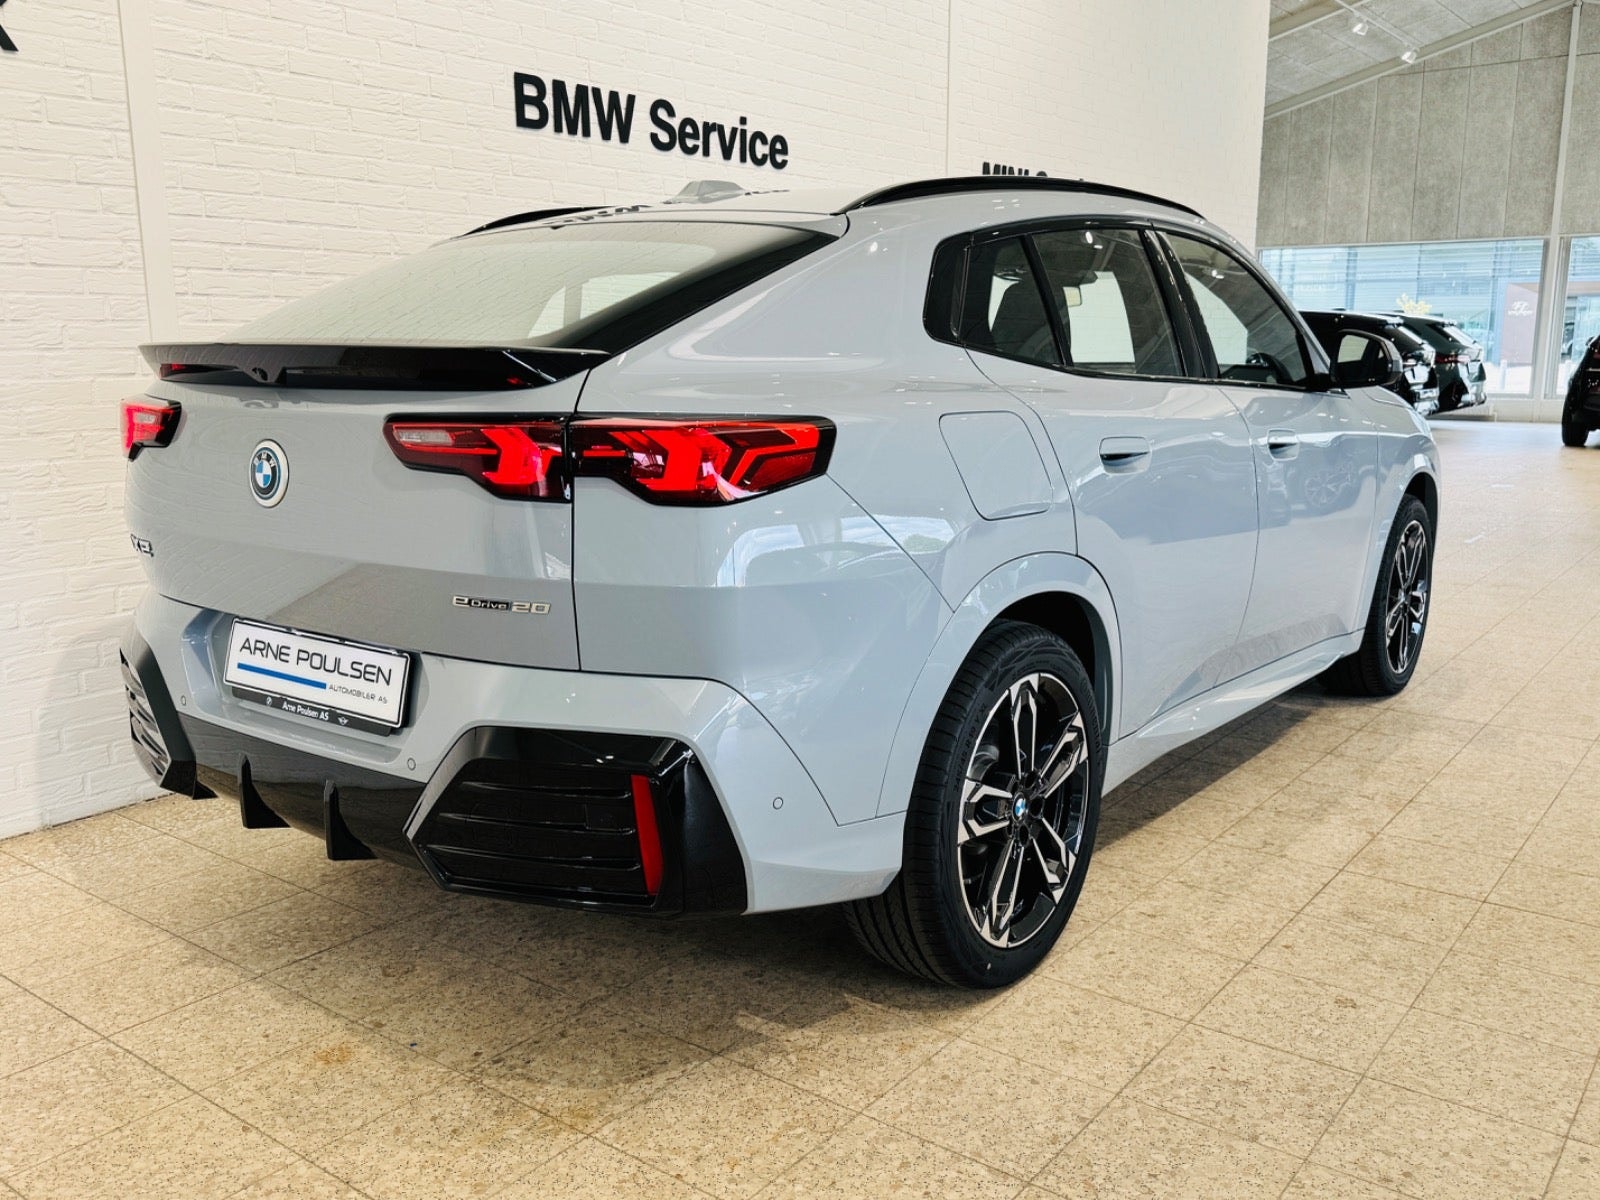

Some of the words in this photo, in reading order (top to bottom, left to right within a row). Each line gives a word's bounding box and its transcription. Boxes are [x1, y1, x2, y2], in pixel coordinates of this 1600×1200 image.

[514, 71, 636, 144] BMW
[649, 98, 789, 170] Service
[511, 601, 551, 615] 20
[239, 637, 291, 663] ARNE
[296, 648, 392, 686] POULSEN
[328, 684, 376, 701] AUTOMOBILER
[378, 695, 388, 704] AS
[282, 700, 297, 712] Arne
[296, 704, 319, 718] Poulsen
[319, 711, 330, 721] AS
